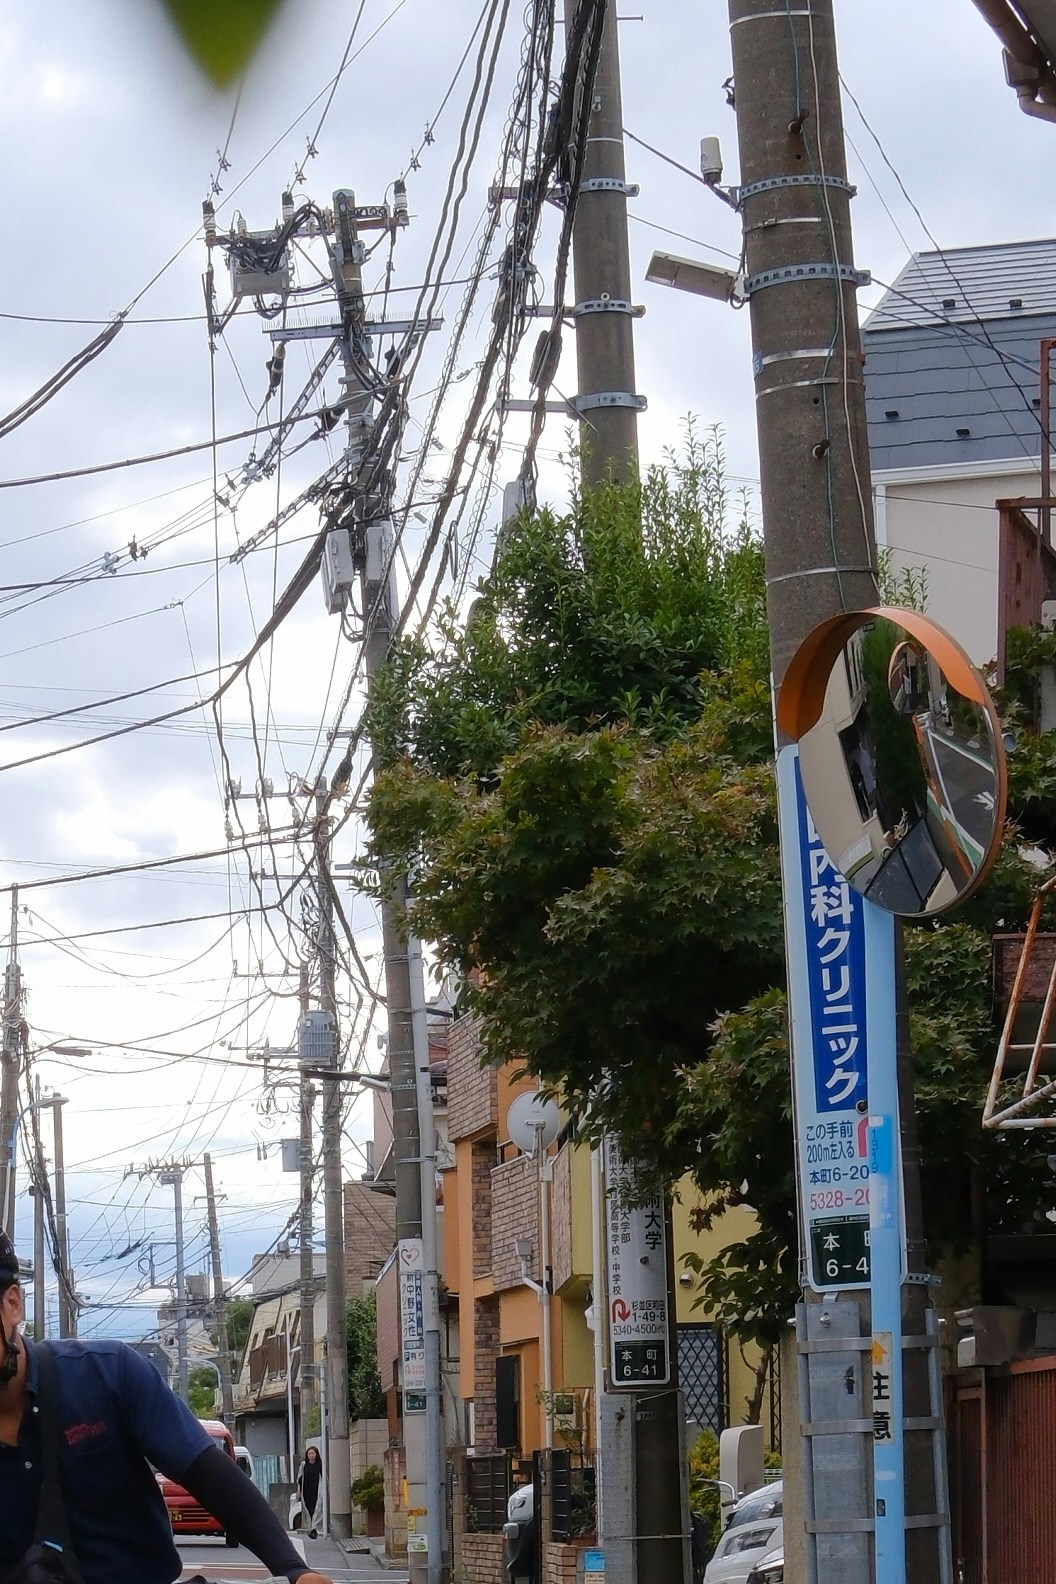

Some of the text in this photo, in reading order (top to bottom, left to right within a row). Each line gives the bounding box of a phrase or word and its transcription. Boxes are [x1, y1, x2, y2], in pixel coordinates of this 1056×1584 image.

[806, 1120, 853, 1141] この手前
[807, 1141, 855, 1163] 200m左入る
[632, 1311, 666, 1322] 1-49-8
[623, 1364, 657, 1377] 6-41
